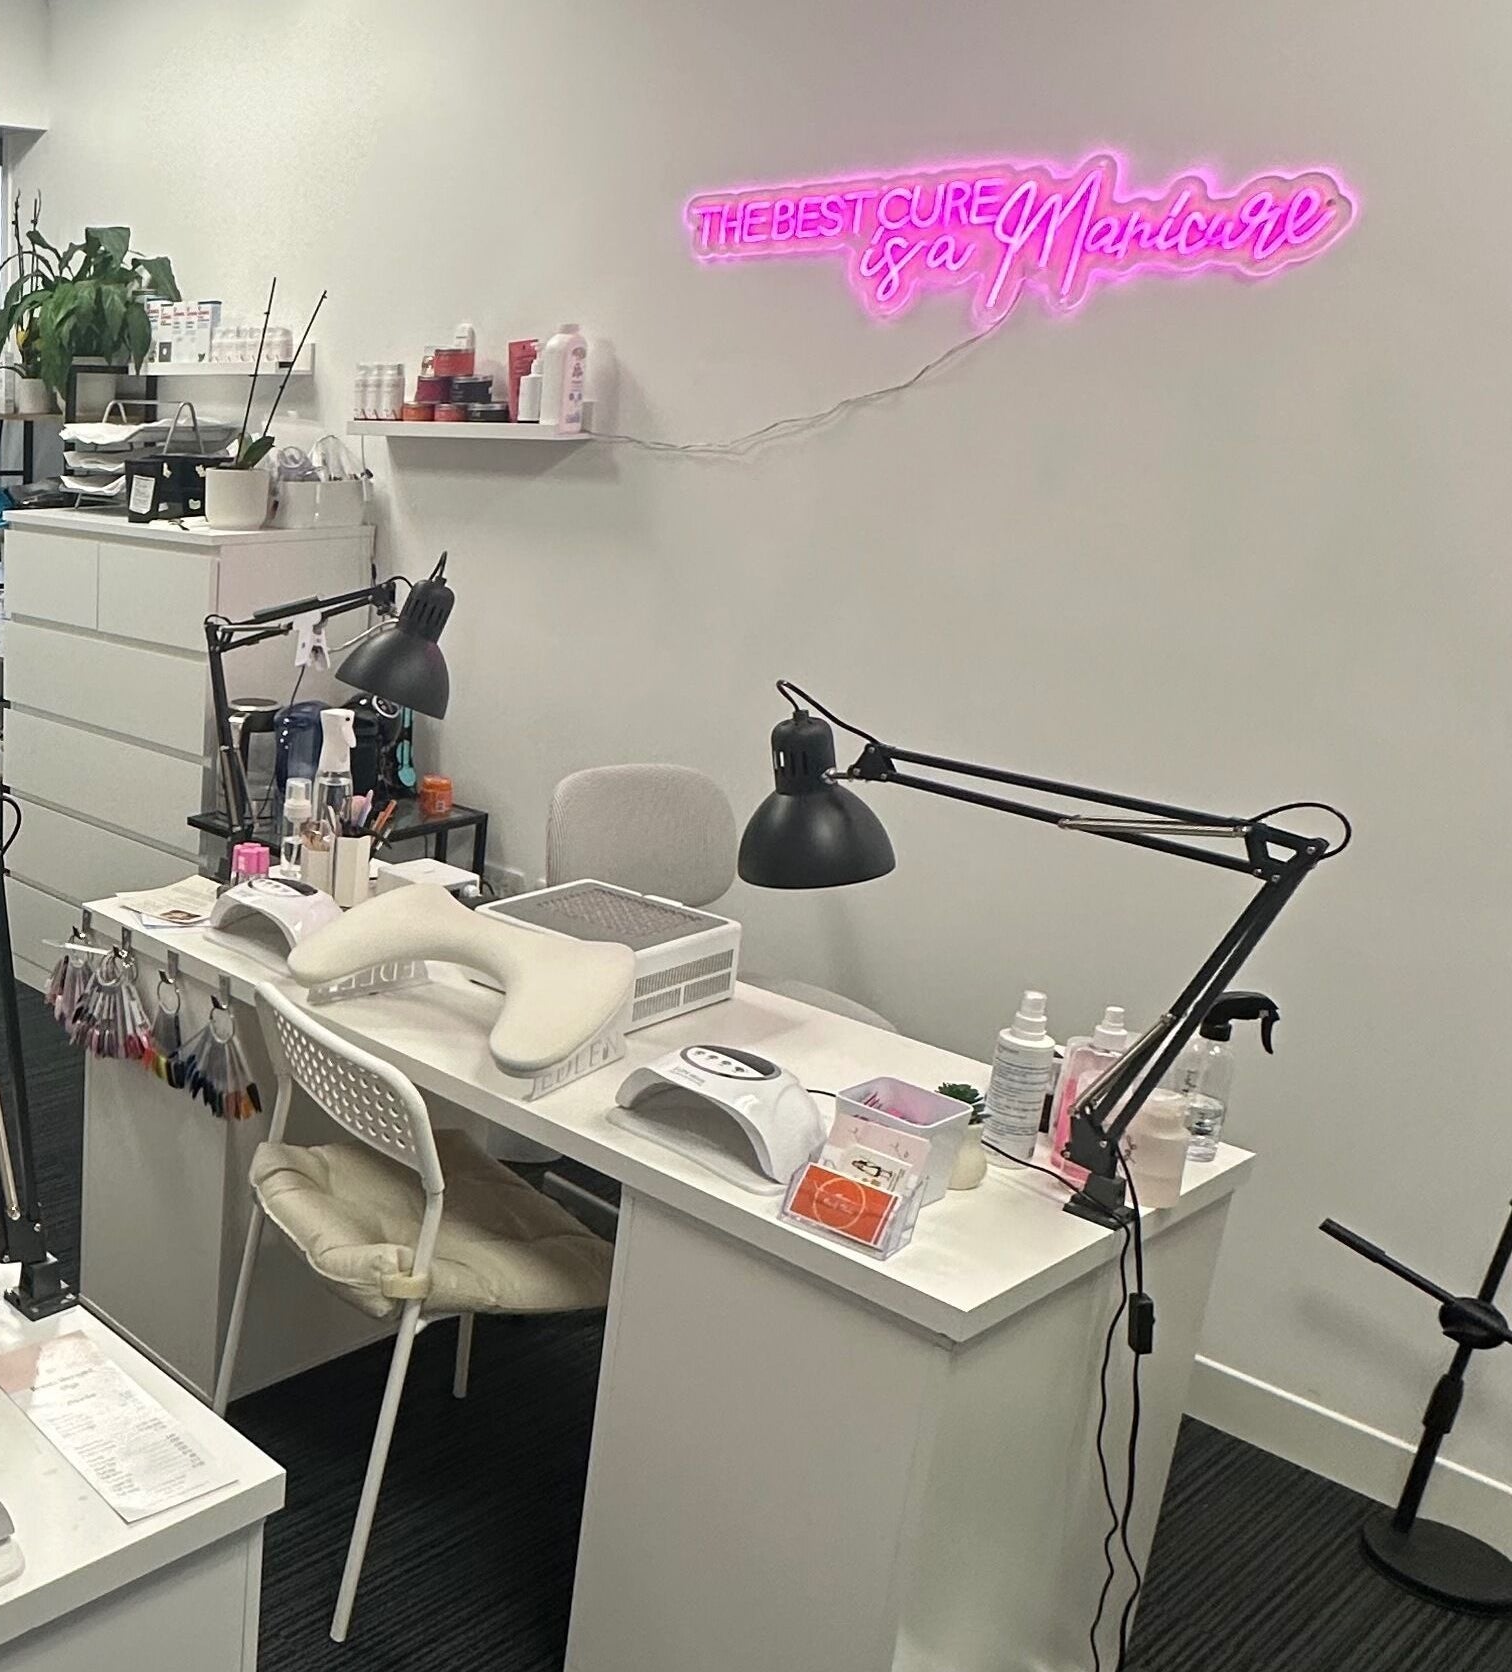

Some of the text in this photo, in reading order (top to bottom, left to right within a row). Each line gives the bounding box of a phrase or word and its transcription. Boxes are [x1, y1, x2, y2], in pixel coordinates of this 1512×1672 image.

[692, 177, 1007, 247] THE BEST CURE
[859, 169, 1337, 308] is a Manicure
